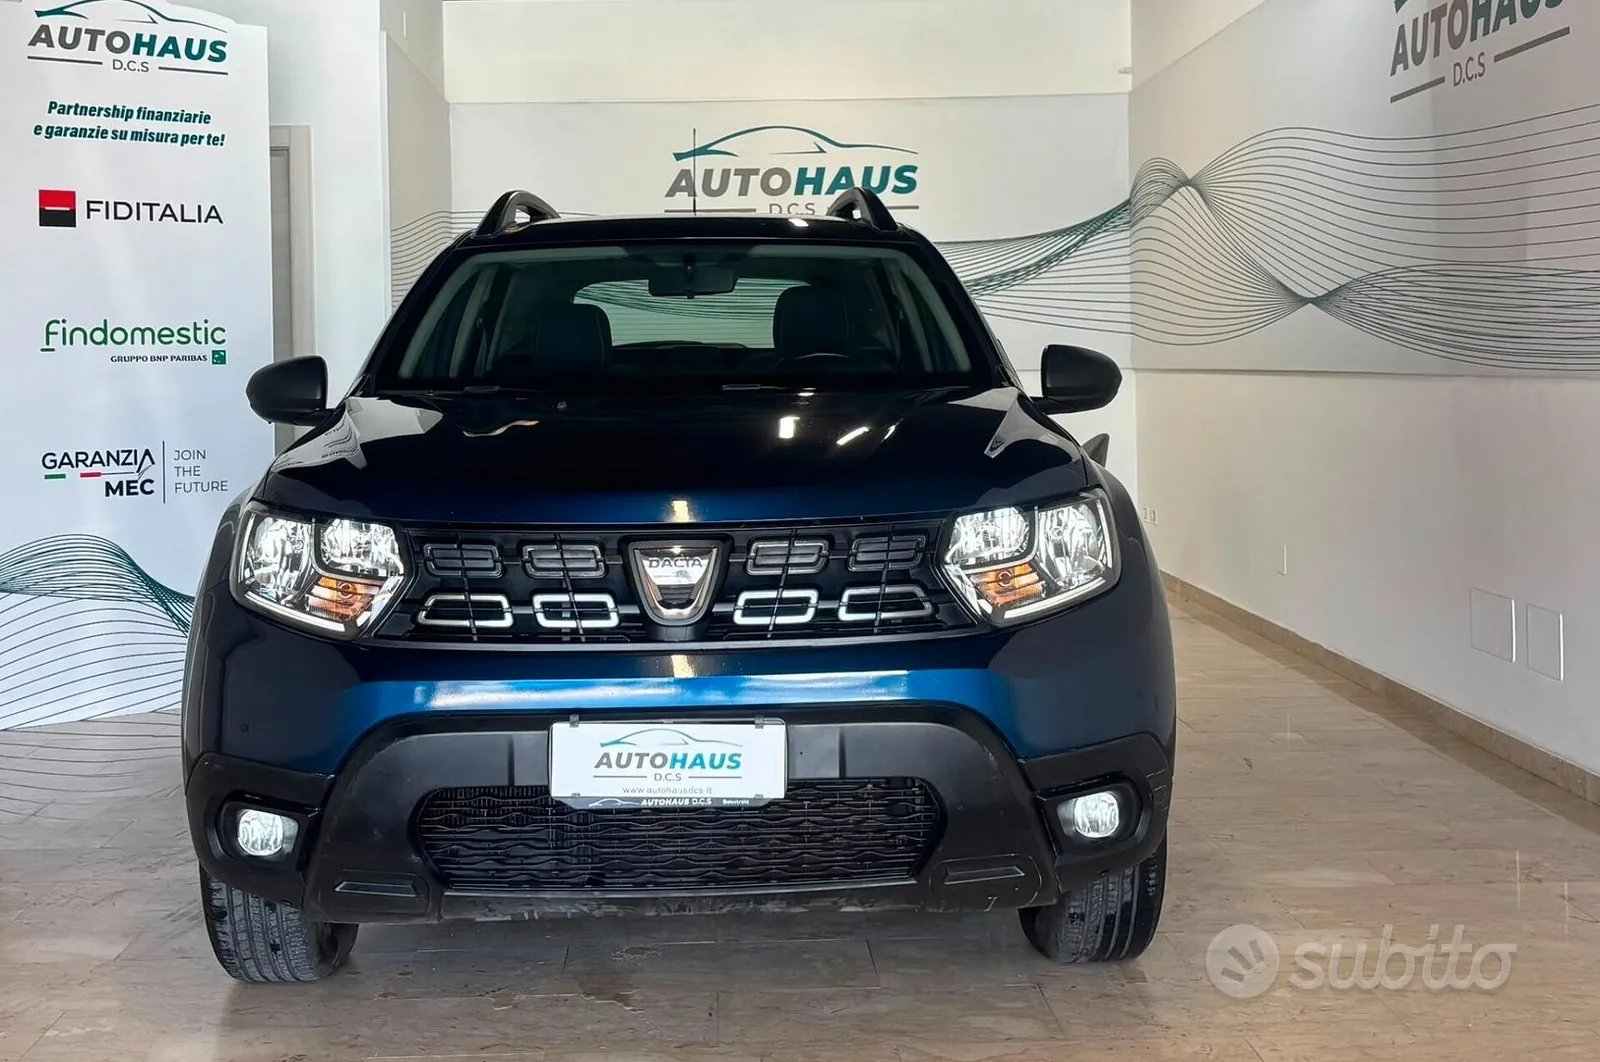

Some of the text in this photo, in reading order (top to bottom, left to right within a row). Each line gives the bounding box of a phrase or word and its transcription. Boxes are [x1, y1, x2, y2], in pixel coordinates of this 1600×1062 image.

[28, 24, 227, 62] AUTOHAUS
[1390, 0, 1563, 77] AUTOHA
[112, 59, 149, 72] D.C.S
[1453, 52, 1485, 87] D.C.S
[48, 101, 211, 124] Partnership finanziarie
[33, 124, 225, 147] e garanzie su misura per te!
[665, 165, 918, 197] AUTOHAUS
[86, 200, 224, 224] FIDITALIA
[45, 319, 227, 347] findomestic
[110, 354, 208, 363] GRUPPO BNP PARIBAS
[41, 449, 155, 472] GARANZIA
[174, 450, 206, 461] JOIN
[174, 466, 201, 477] THE
[105, 479, 155, 497] MEC
[174, 481, 228, 493] FUTURE
[648, 556, 703, 569] DACIA
[594, 752, 742, 770] AUTOHAUS
[654, 773, 682, 782] D.C.S
[641, 798, 690, 806] AUTOHAUS
